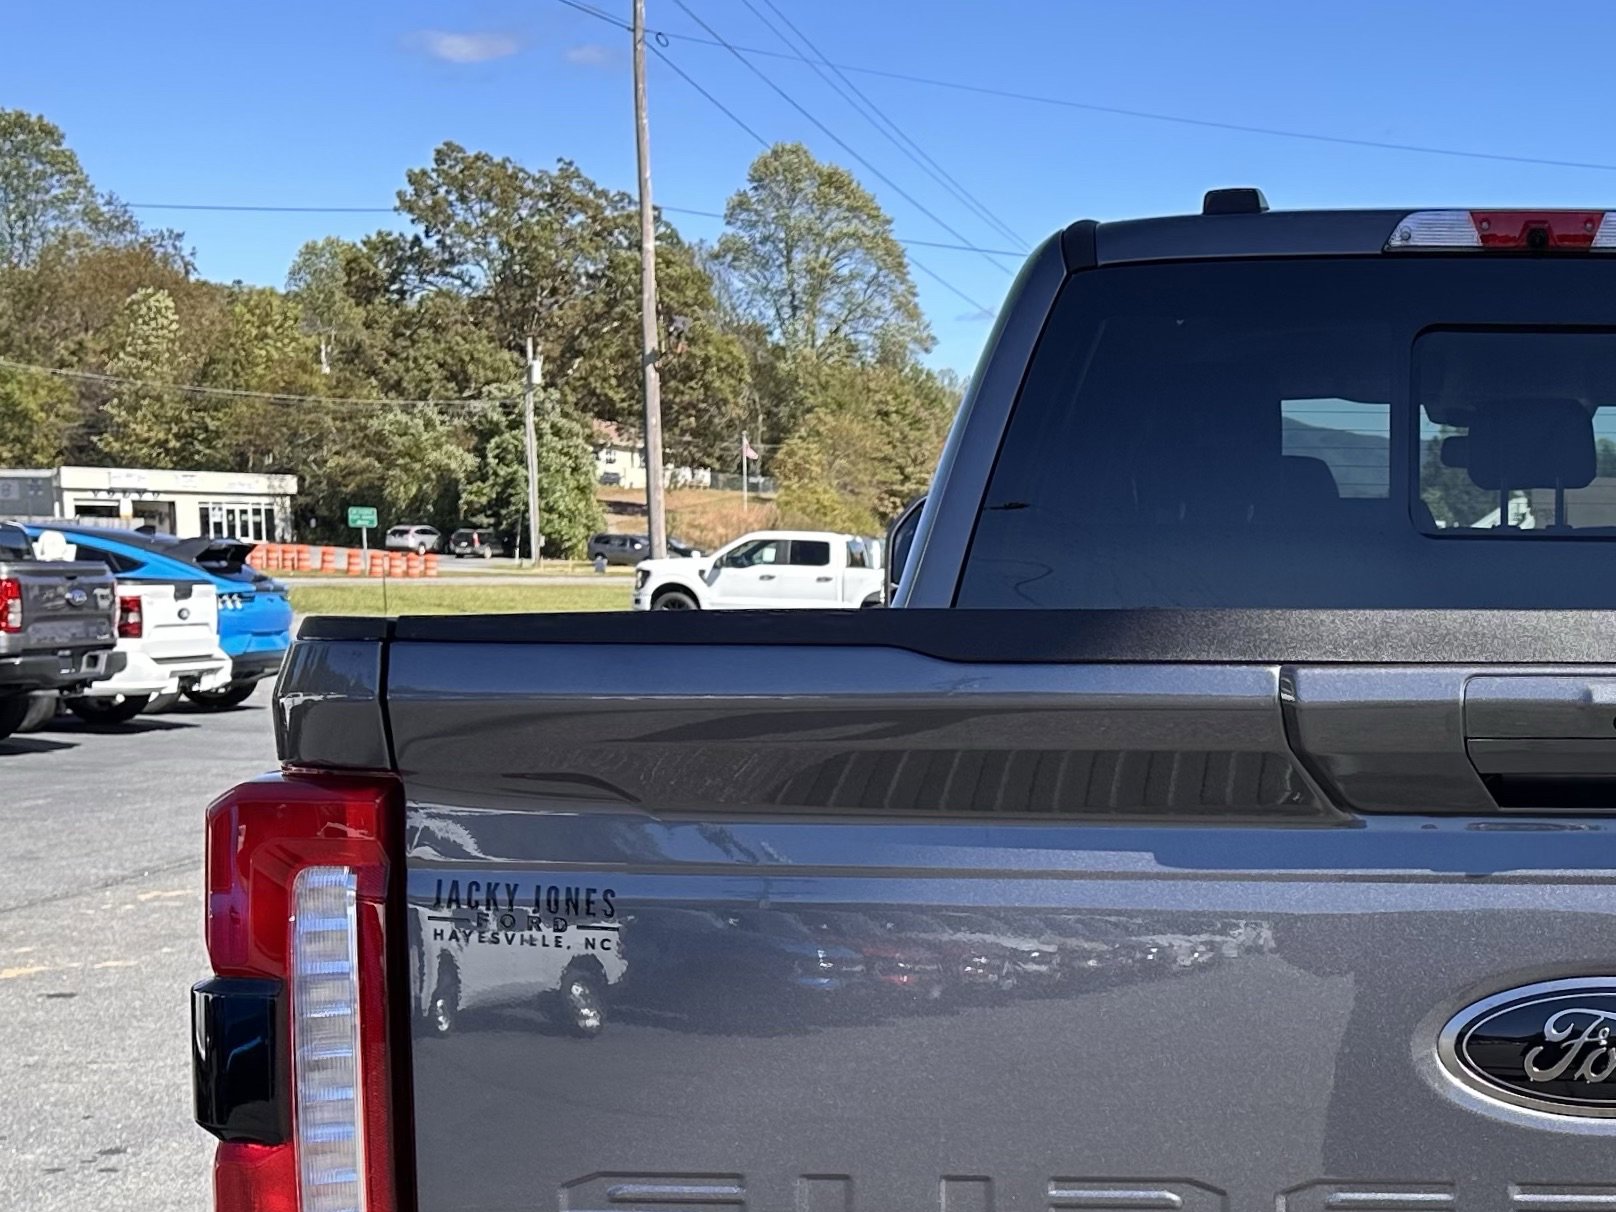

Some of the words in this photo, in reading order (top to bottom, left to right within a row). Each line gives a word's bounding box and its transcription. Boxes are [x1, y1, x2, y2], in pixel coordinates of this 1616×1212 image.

[433, 878, 520, 913] JACKY
[532, 884, 617, 918] JONES
[476, 912, 568, 933] FORD
[433, 928, 571, 950] HAYESVILLE,
[584, 937, 612, 951] NC
